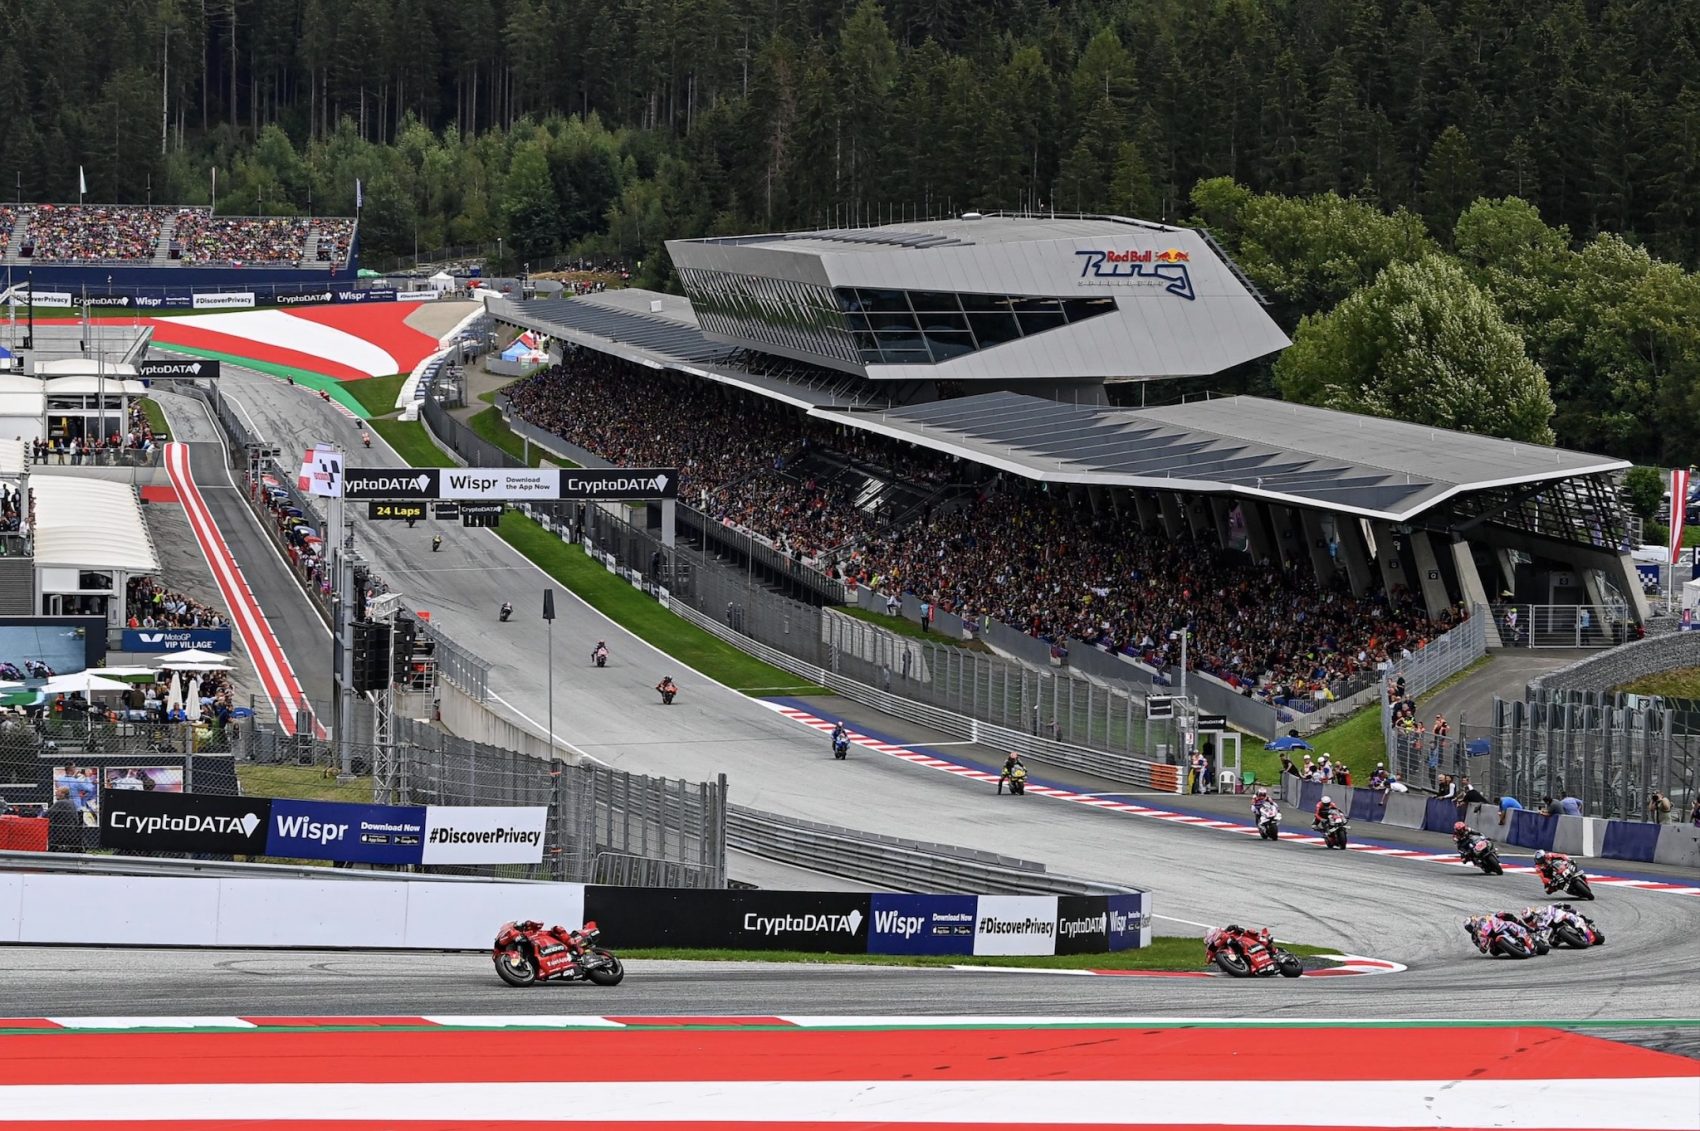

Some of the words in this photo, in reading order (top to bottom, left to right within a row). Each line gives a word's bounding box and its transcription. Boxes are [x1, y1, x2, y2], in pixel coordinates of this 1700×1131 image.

[1107, 250, 1129, 263] Red
[1130, 250, 1152, 263] Bull
[135, 297, 162, 306] Wispr
[277, 294, 327, 304] CryptoDATA
[339, 291, 366, 301] Wispr
[140, 365, 194, 375] yptoDATA
[345, 477, 420, 493] yptoDATA
[450, 475, 499, 492] Wispr
[568, 478, 658, 494] CryptoDATA
[376, 507, 391, 516] 24
[394, 506, 421, 517] Laps
[110, 811, 245, 834] CryptoDATA
[276, 815, 349, 845] Wispr
[360, 821, 403, 831] Download
[403, 824, 421, 832] Now
[429, 827, 541, 846] #DiscoverPrivacy
[744, 913, 851, 936] CryptoDATA
[875, 910, 925, 939] Wispr
[932, 913, 960, 921] Download
[960, 913, 973, 921] Now
[979, 917, 1055, 938] #DiscoverPrivacy
[1059, 917, 1103, 938] CryptoDATA
